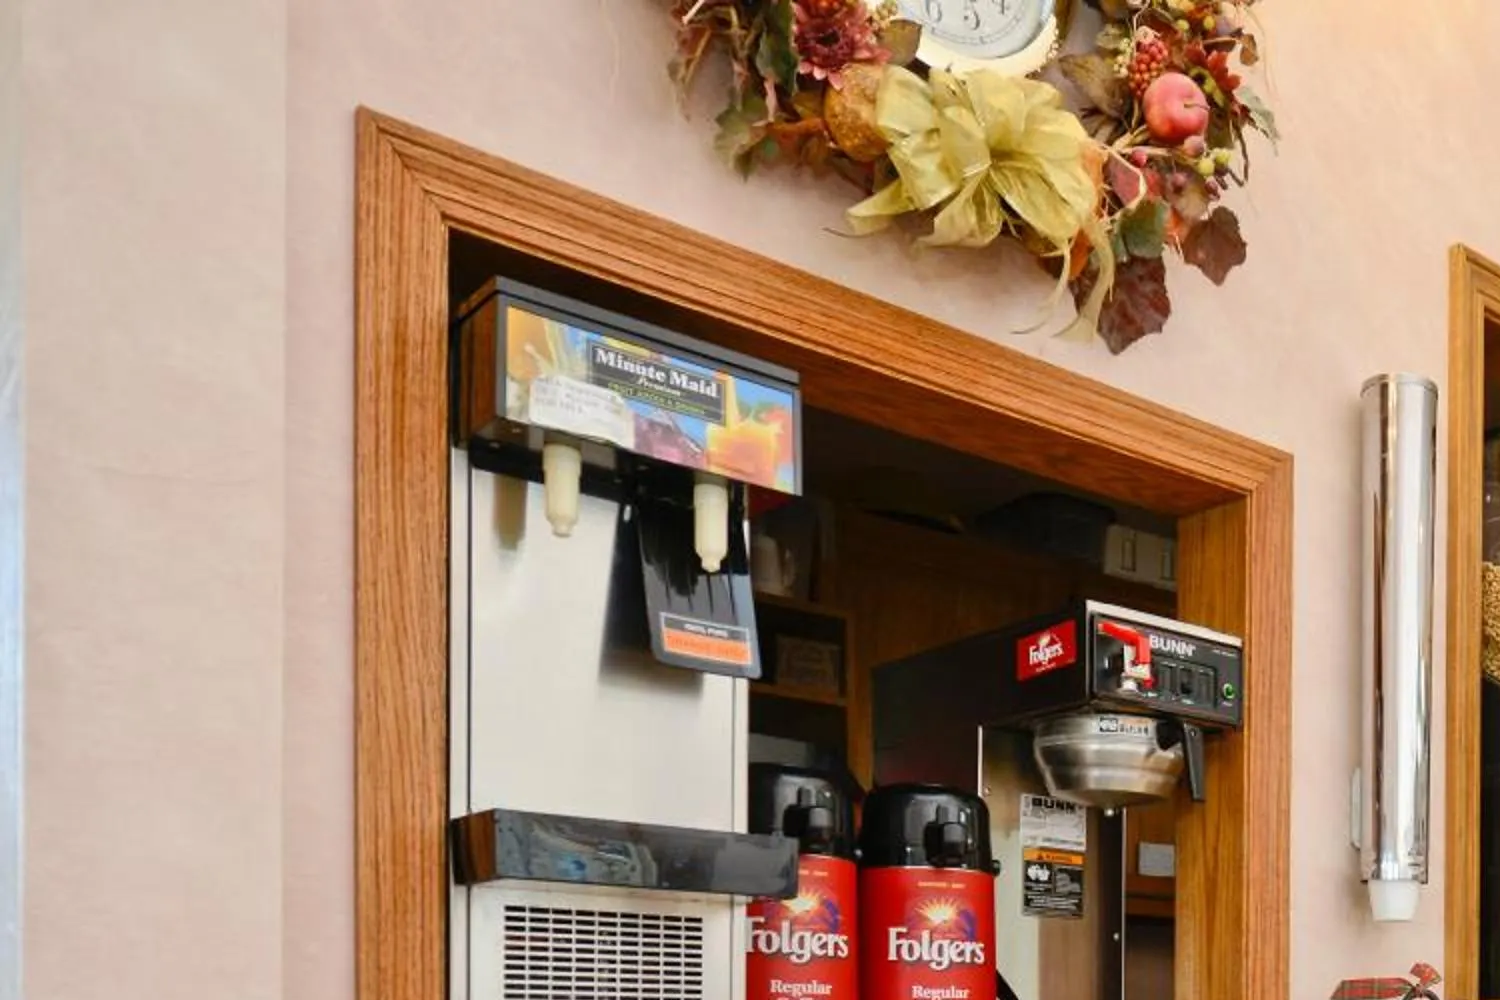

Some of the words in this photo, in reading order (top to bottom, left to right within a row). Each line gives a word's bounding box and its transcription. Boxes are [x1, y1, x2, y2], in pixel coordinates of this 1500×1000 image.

[595, 348, 666, 383] Minute
[669, 370, 719, 397] Maid
[1029, 642, 1064, 665] Folgers
[1149, 634, 1193, 656] BUNN
[746, 916, 849, 964] Folgers
[888, 927, 985, 971] Folgers
[770, 979, 832, 997] Regular
